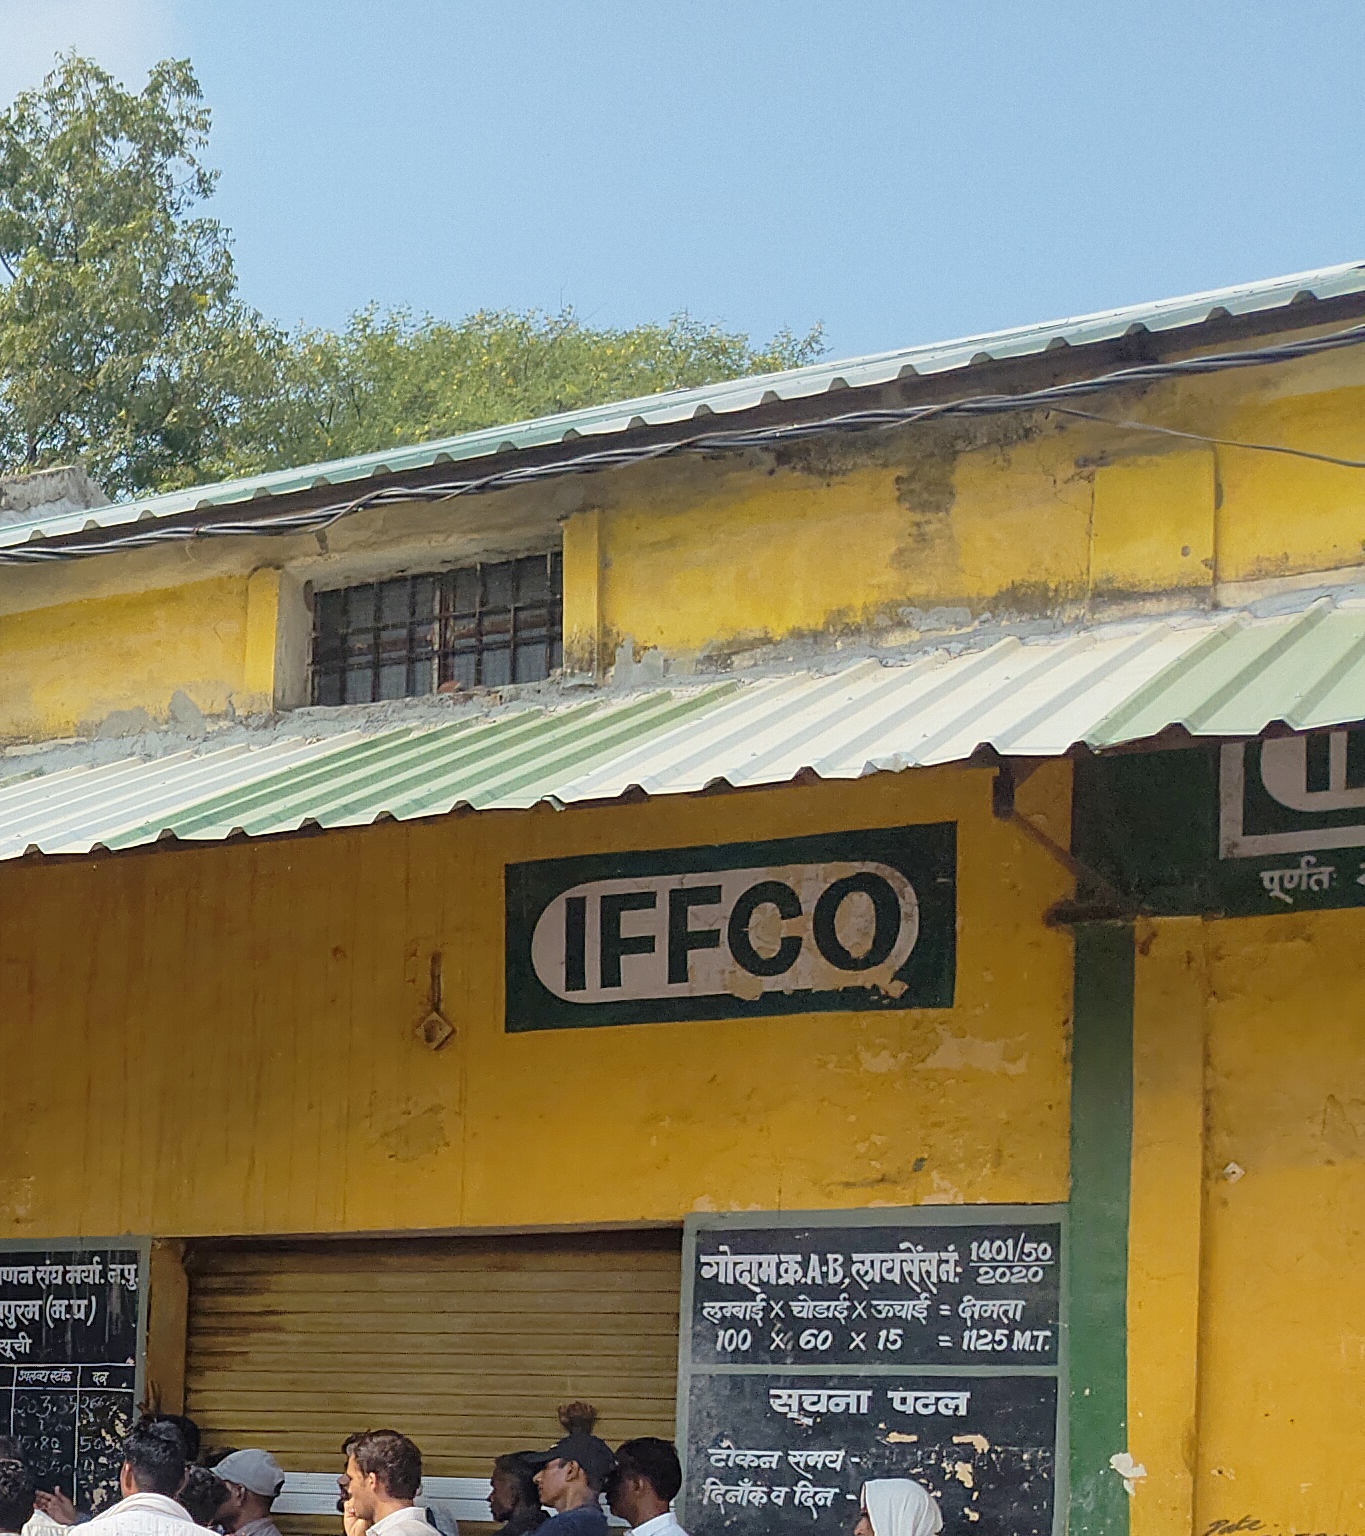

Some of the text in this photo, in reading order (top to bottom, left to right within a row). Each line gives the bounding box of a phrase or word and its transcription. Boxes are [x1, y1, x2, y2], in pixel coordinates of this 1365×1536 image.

[563, 871, 902, 993] IFFCO
[700, 1245, 778, 1292] गोदाम
[969, 1232, 1053, 1263] 1401/50
[975, 1266, 1044, 1285] 2020
[958, 1295, 1027, 1327] क्षमता
[715, 1327, 752, 1352] 100
[798, 1328, 833, 1351] 60
[877, 1328, 903, 1351] 15
[961, 1330, 1008, 1352] 1125
[769, 1388, 971, 1427] सूचना पटल
[793, 1480, 840, 1519] दिन
